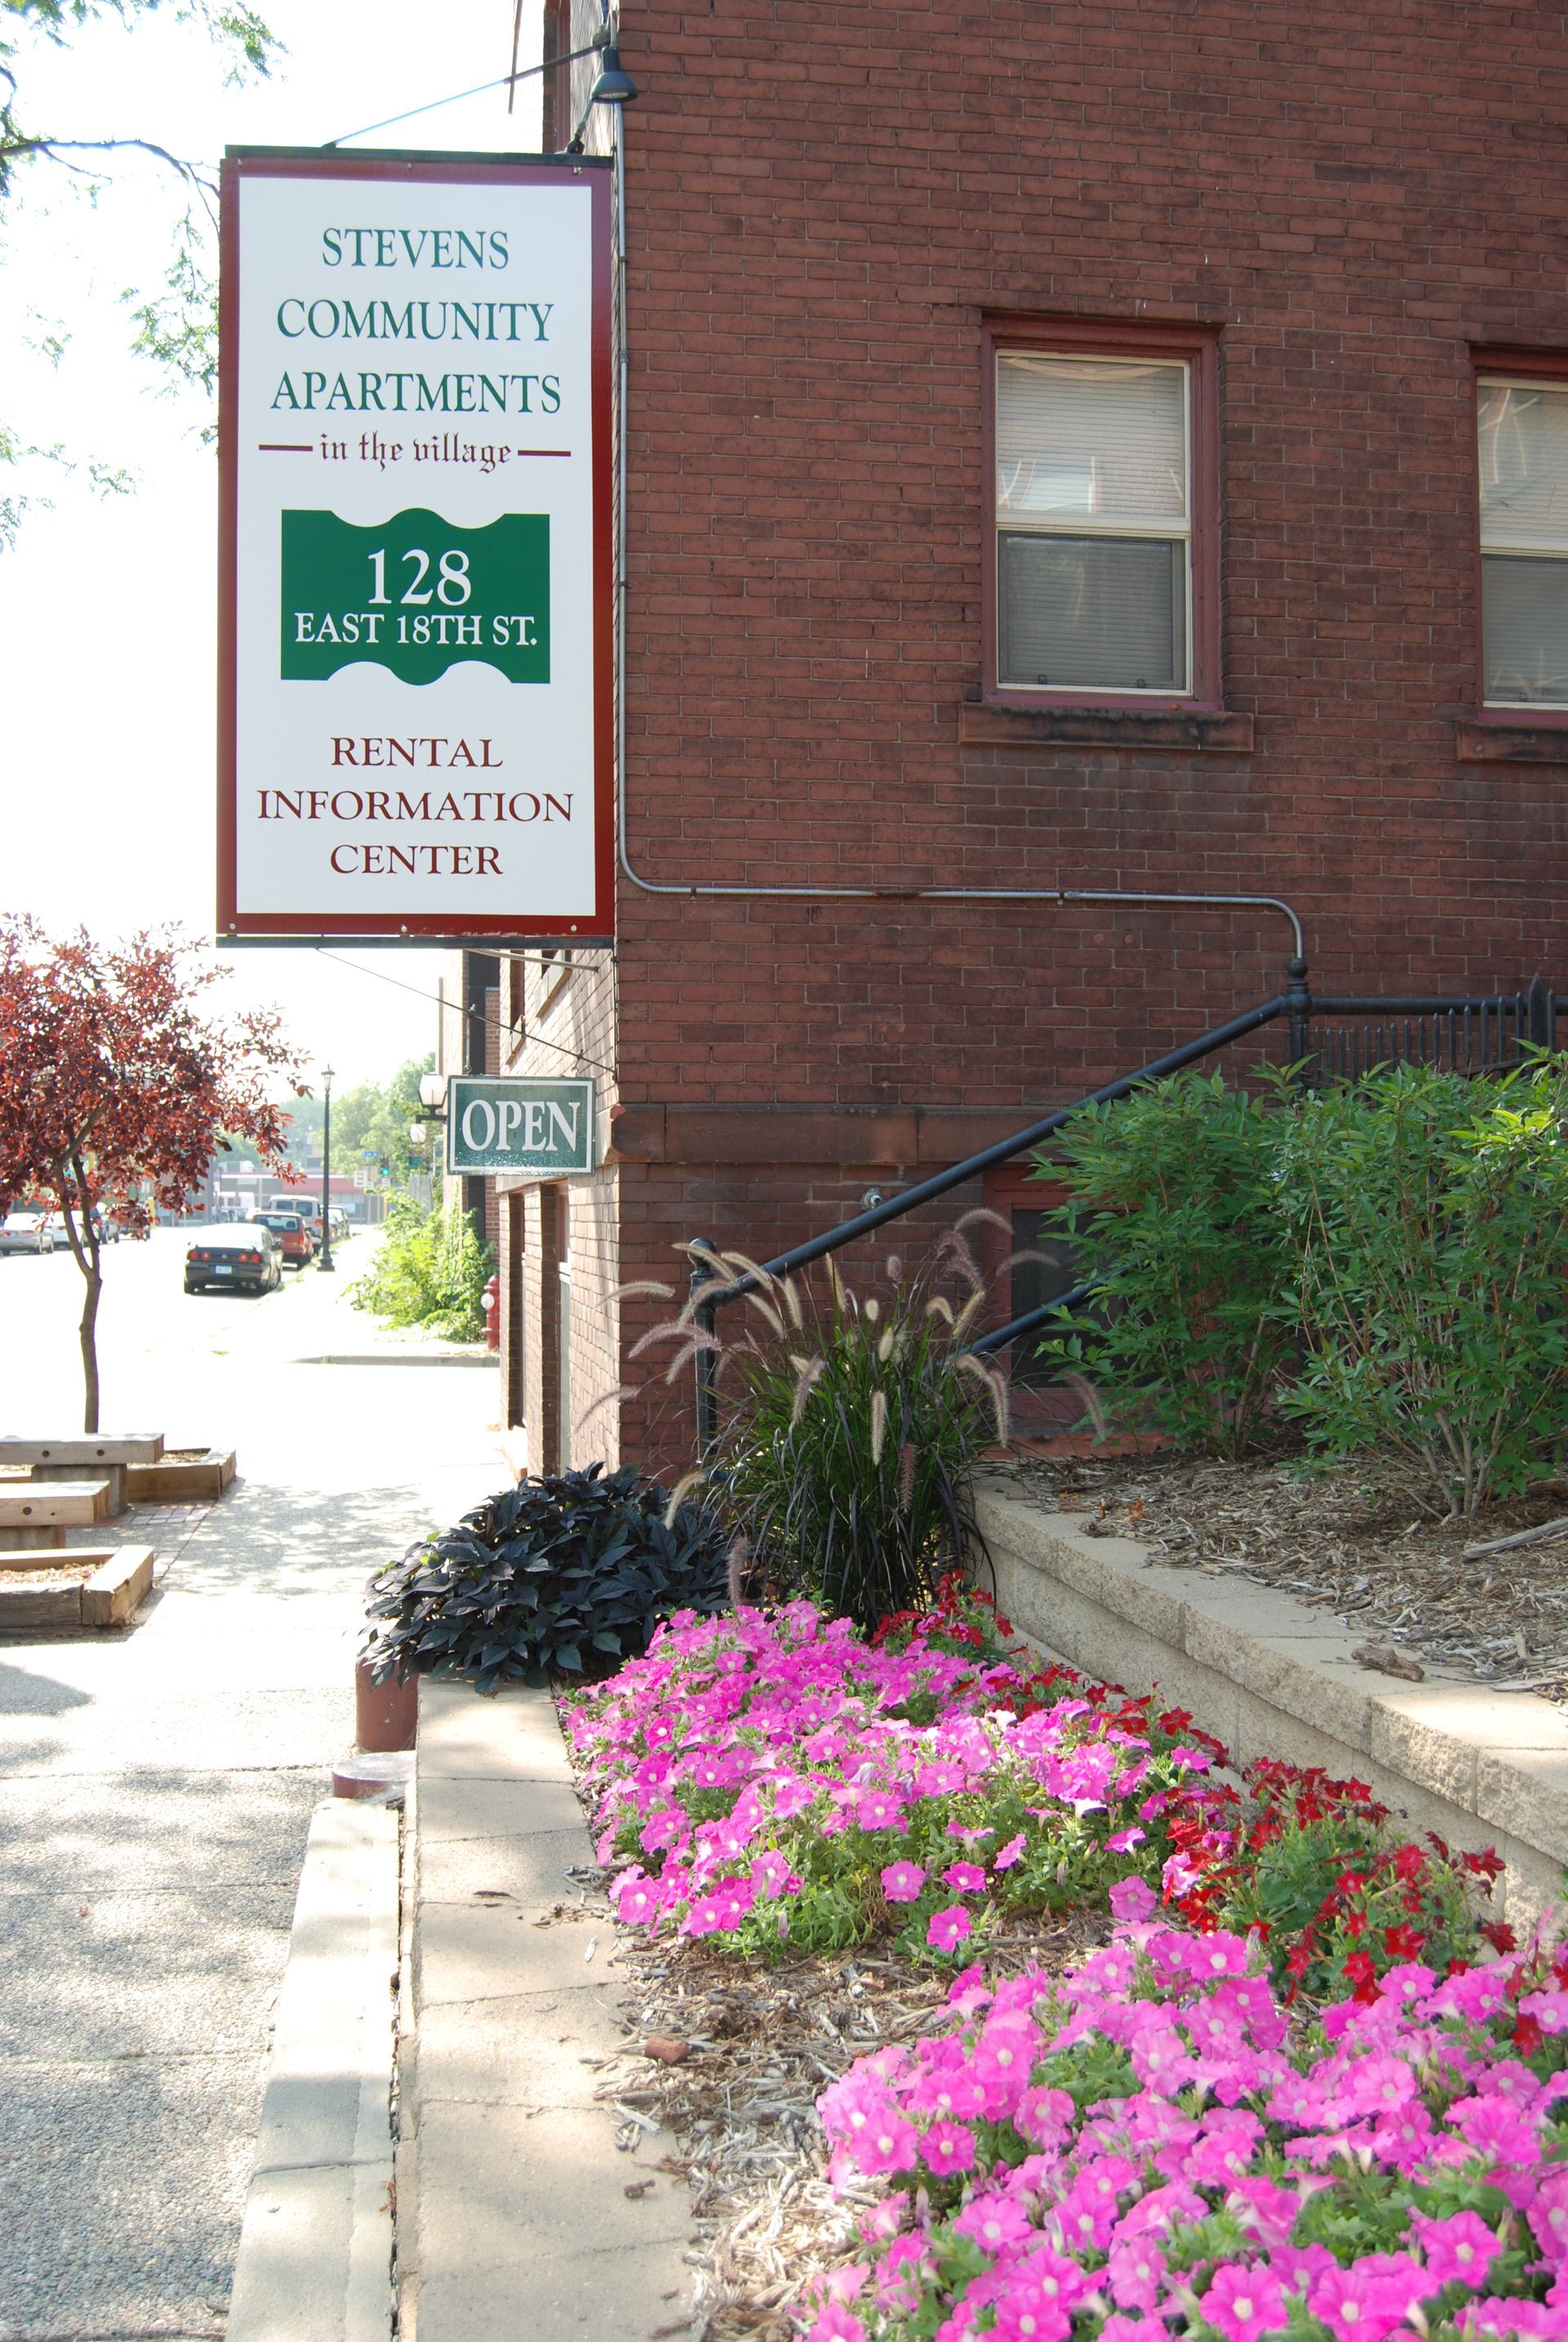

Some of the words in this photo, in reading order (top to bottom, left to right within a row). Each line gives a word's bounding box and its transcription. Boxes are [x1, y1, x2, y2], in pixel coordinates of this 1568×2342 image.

[322, 227, 509, 269] STEVENS
[277, 298, 555, 342] COMMUNITY
[270, 371, 561, 414] APARTMENTS
[319, 433, 348, 461] in
[358, 430, 403, 472] the
[412, 432, 512, 474] village
[367, 548, 472, 606] 128
[294, 612, 385, 643] EAST
[397, 614, 483, 645] 18TH
[492, 615, 537, 646] ST.
[330, 737, 504, 768] RENTAL
[256, 790, 574, 822] INFORMATION
[330, 844, 504, 875] CENTER
[461, 1099, 581, 1151] OPEN
